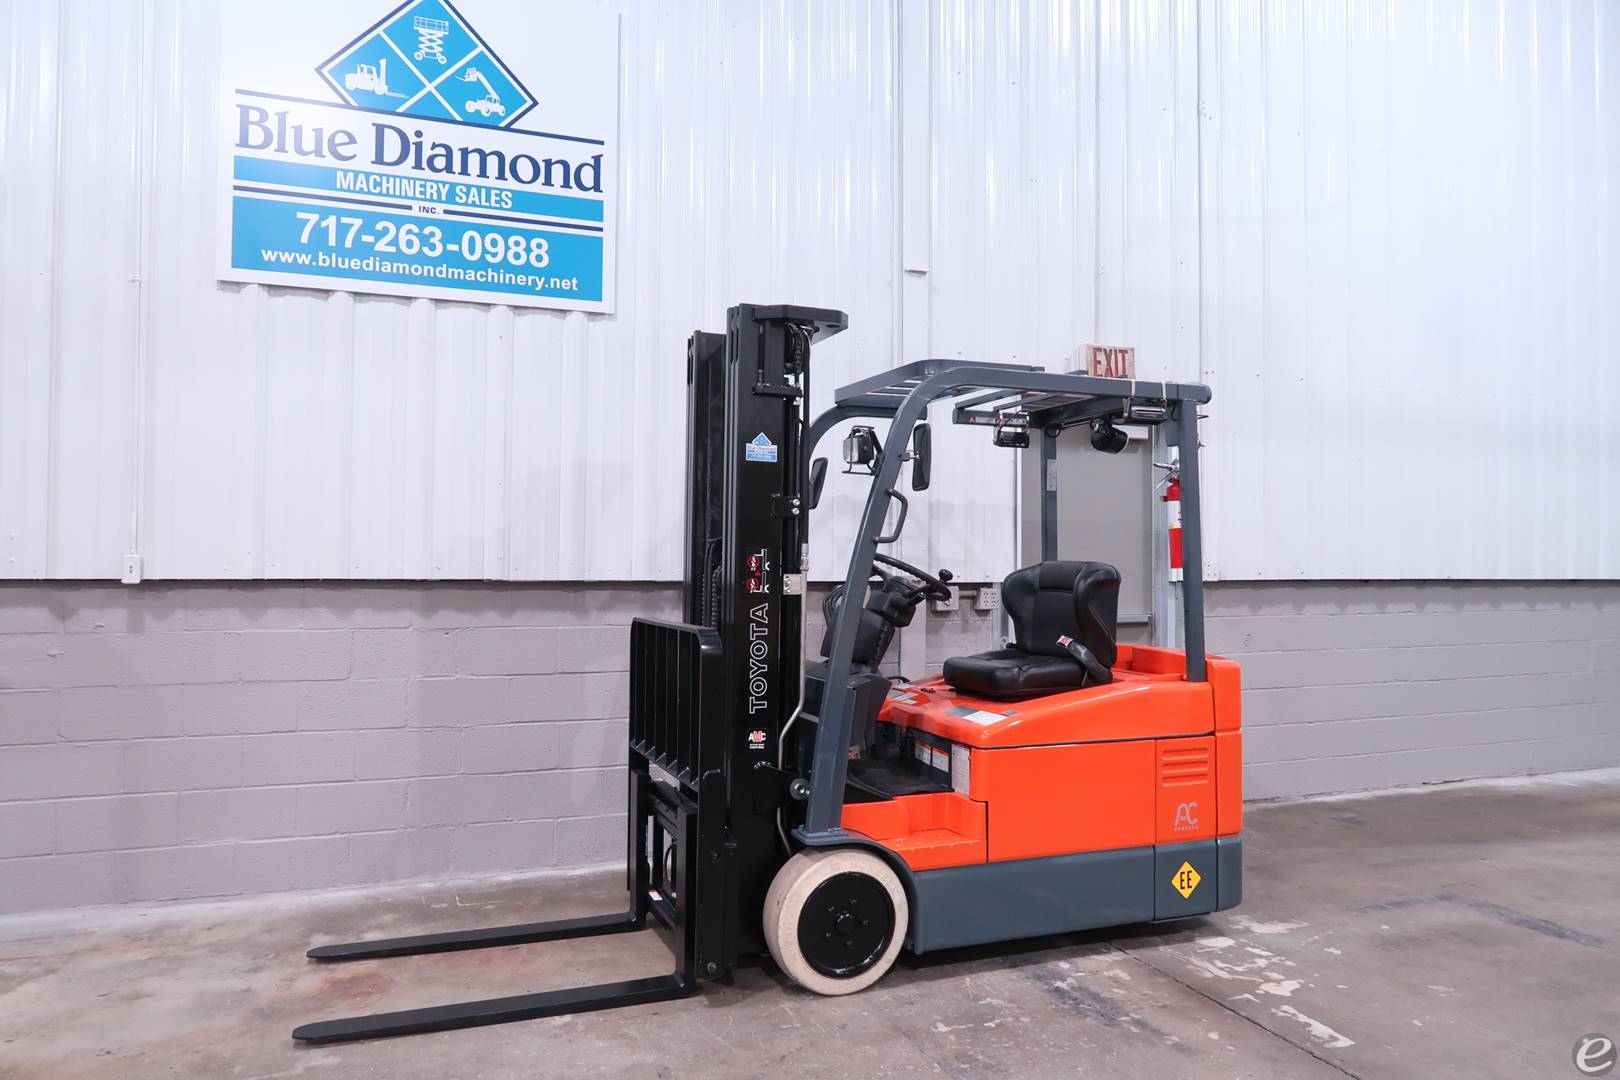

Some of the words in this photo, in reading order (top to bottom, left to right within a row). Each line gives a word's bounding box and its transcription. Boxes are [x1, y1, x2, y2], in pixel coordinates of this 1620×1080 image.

[235, 104, 358, 161] Blue
[371, 123, 603, 193] Diamond
[336, 170, 449, 202] MACHINERY
[455, 185, 513, 209] SALES
[418, 205, 440, 215] INC.
[296, 212, 550, 268] 717-263-0988
[261, 248, 578, 290] www.bluediamondmachinery.net
[1093, 347, 1128, 378] EXIT
[749, 603, 768, 714] TOYOTA
[1175, 802, 1198, 826] AC
[1180, 871, 1192, 889] EE
